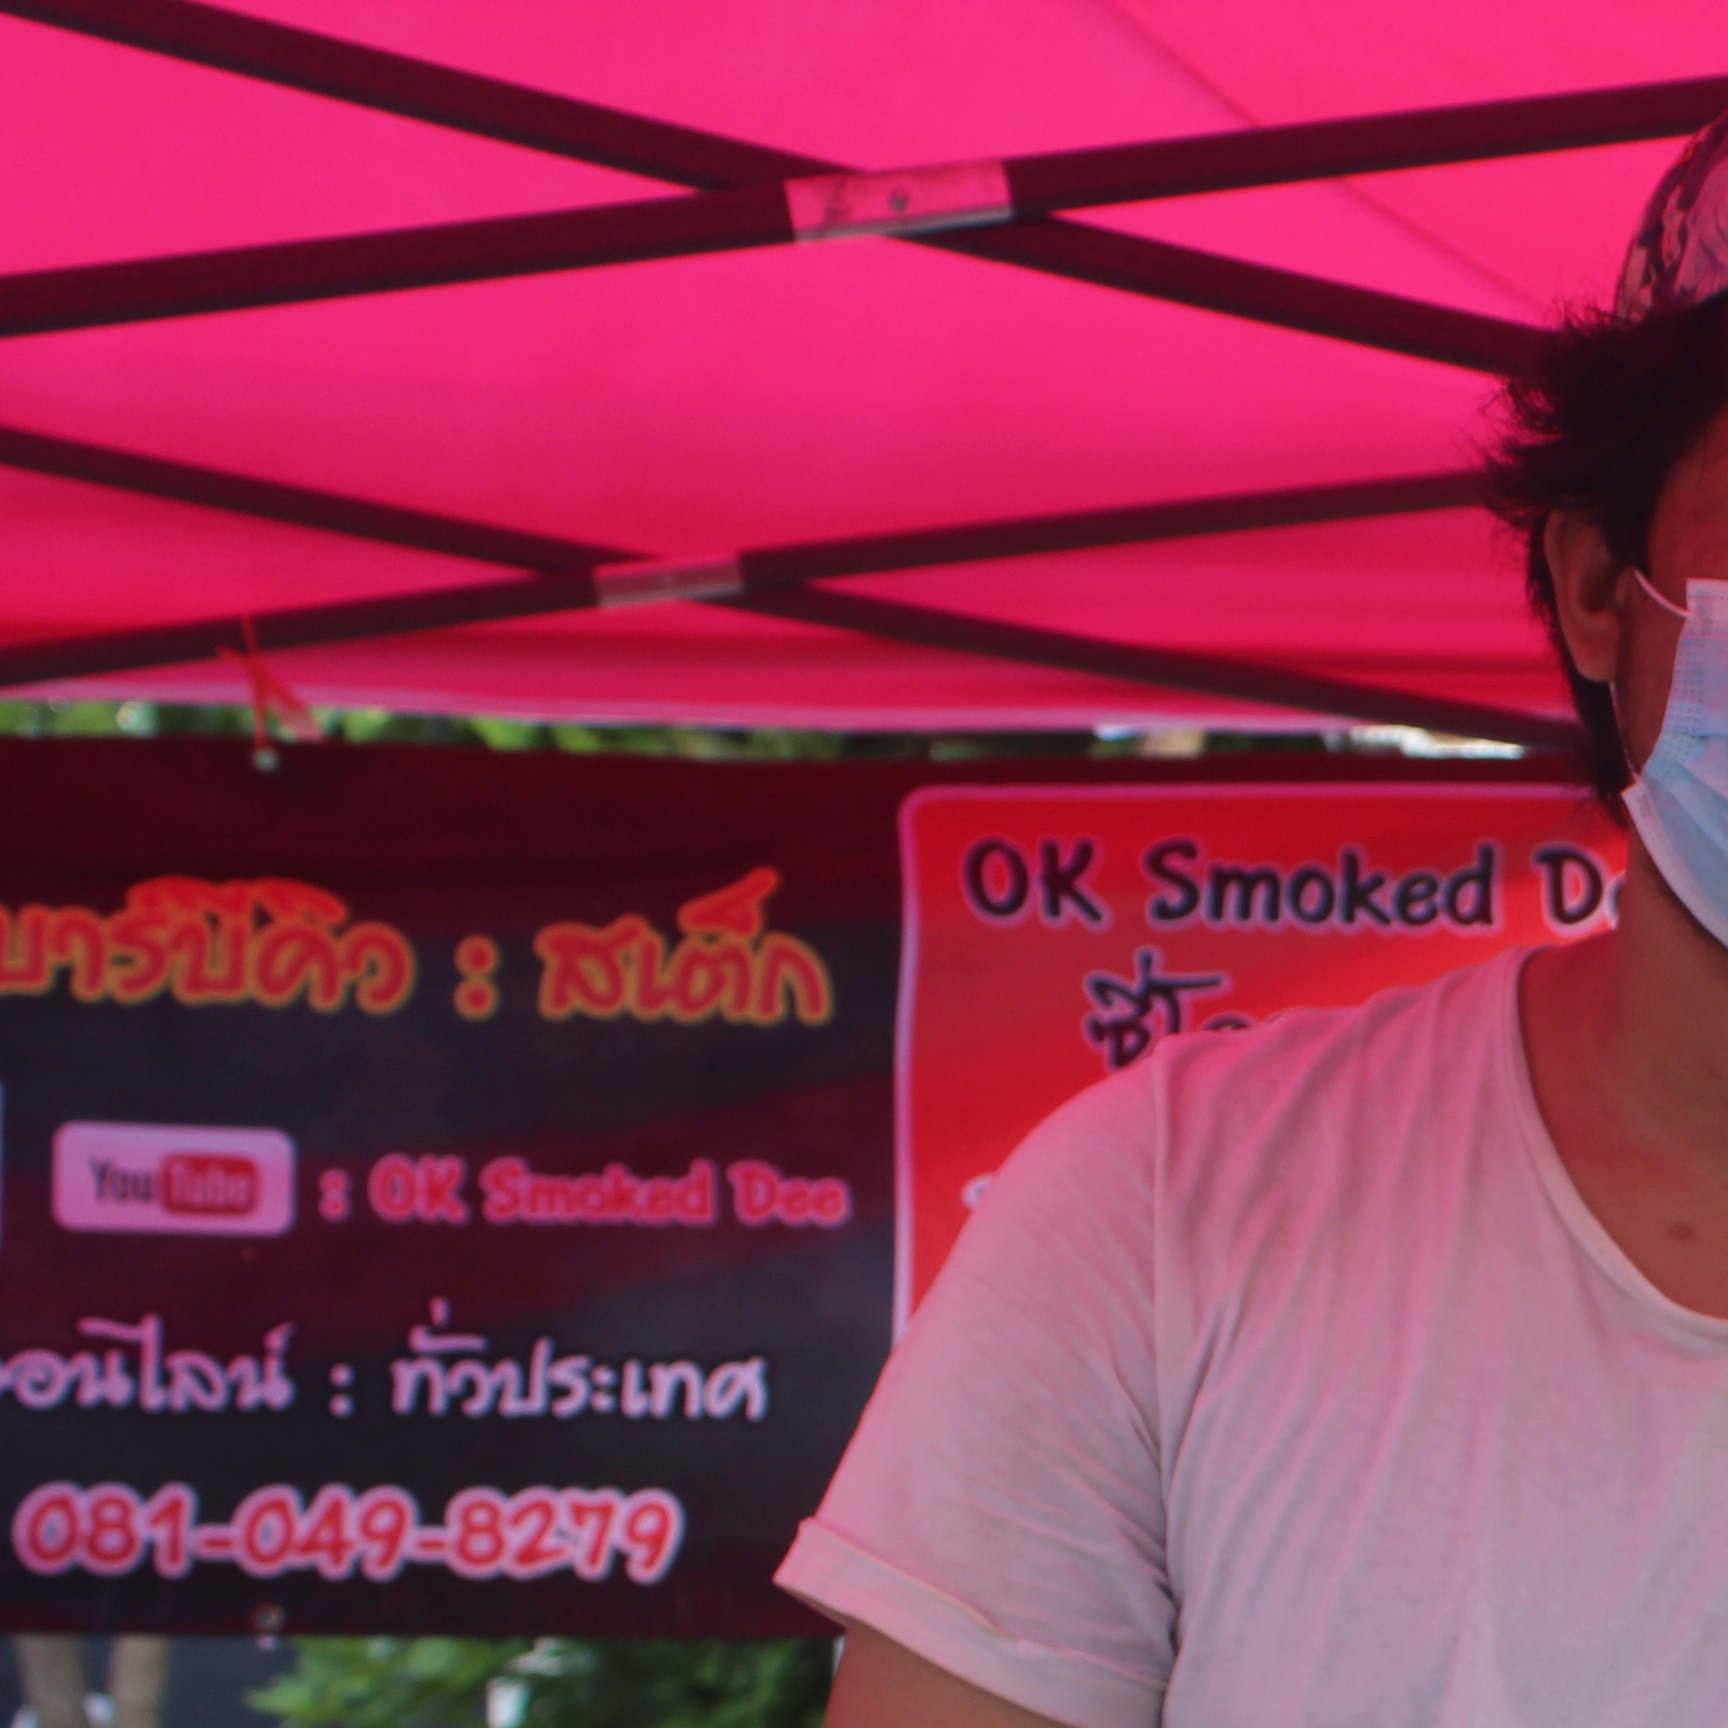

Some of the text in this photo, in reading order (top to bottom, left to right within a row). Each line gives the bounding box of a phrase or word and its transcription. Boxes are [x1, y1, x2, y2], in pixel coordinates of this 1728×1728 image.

[965, 838, 1108, 926] OK
[1144, 840, 1499, 930] Smoked
[90, 1157, 252, 1203] YouTube
[369, 1154, 470, 1224] OK
[479, 1156, 718, 1226] Smoked
[727, 1159, 852, 1228] Dee
[0, 1312, 299, 1413] อนไลน์
[391, 1298, 768, 1421] ทั่วประเทศ
[12, 1481, 685, 1582] 081-049-8279
